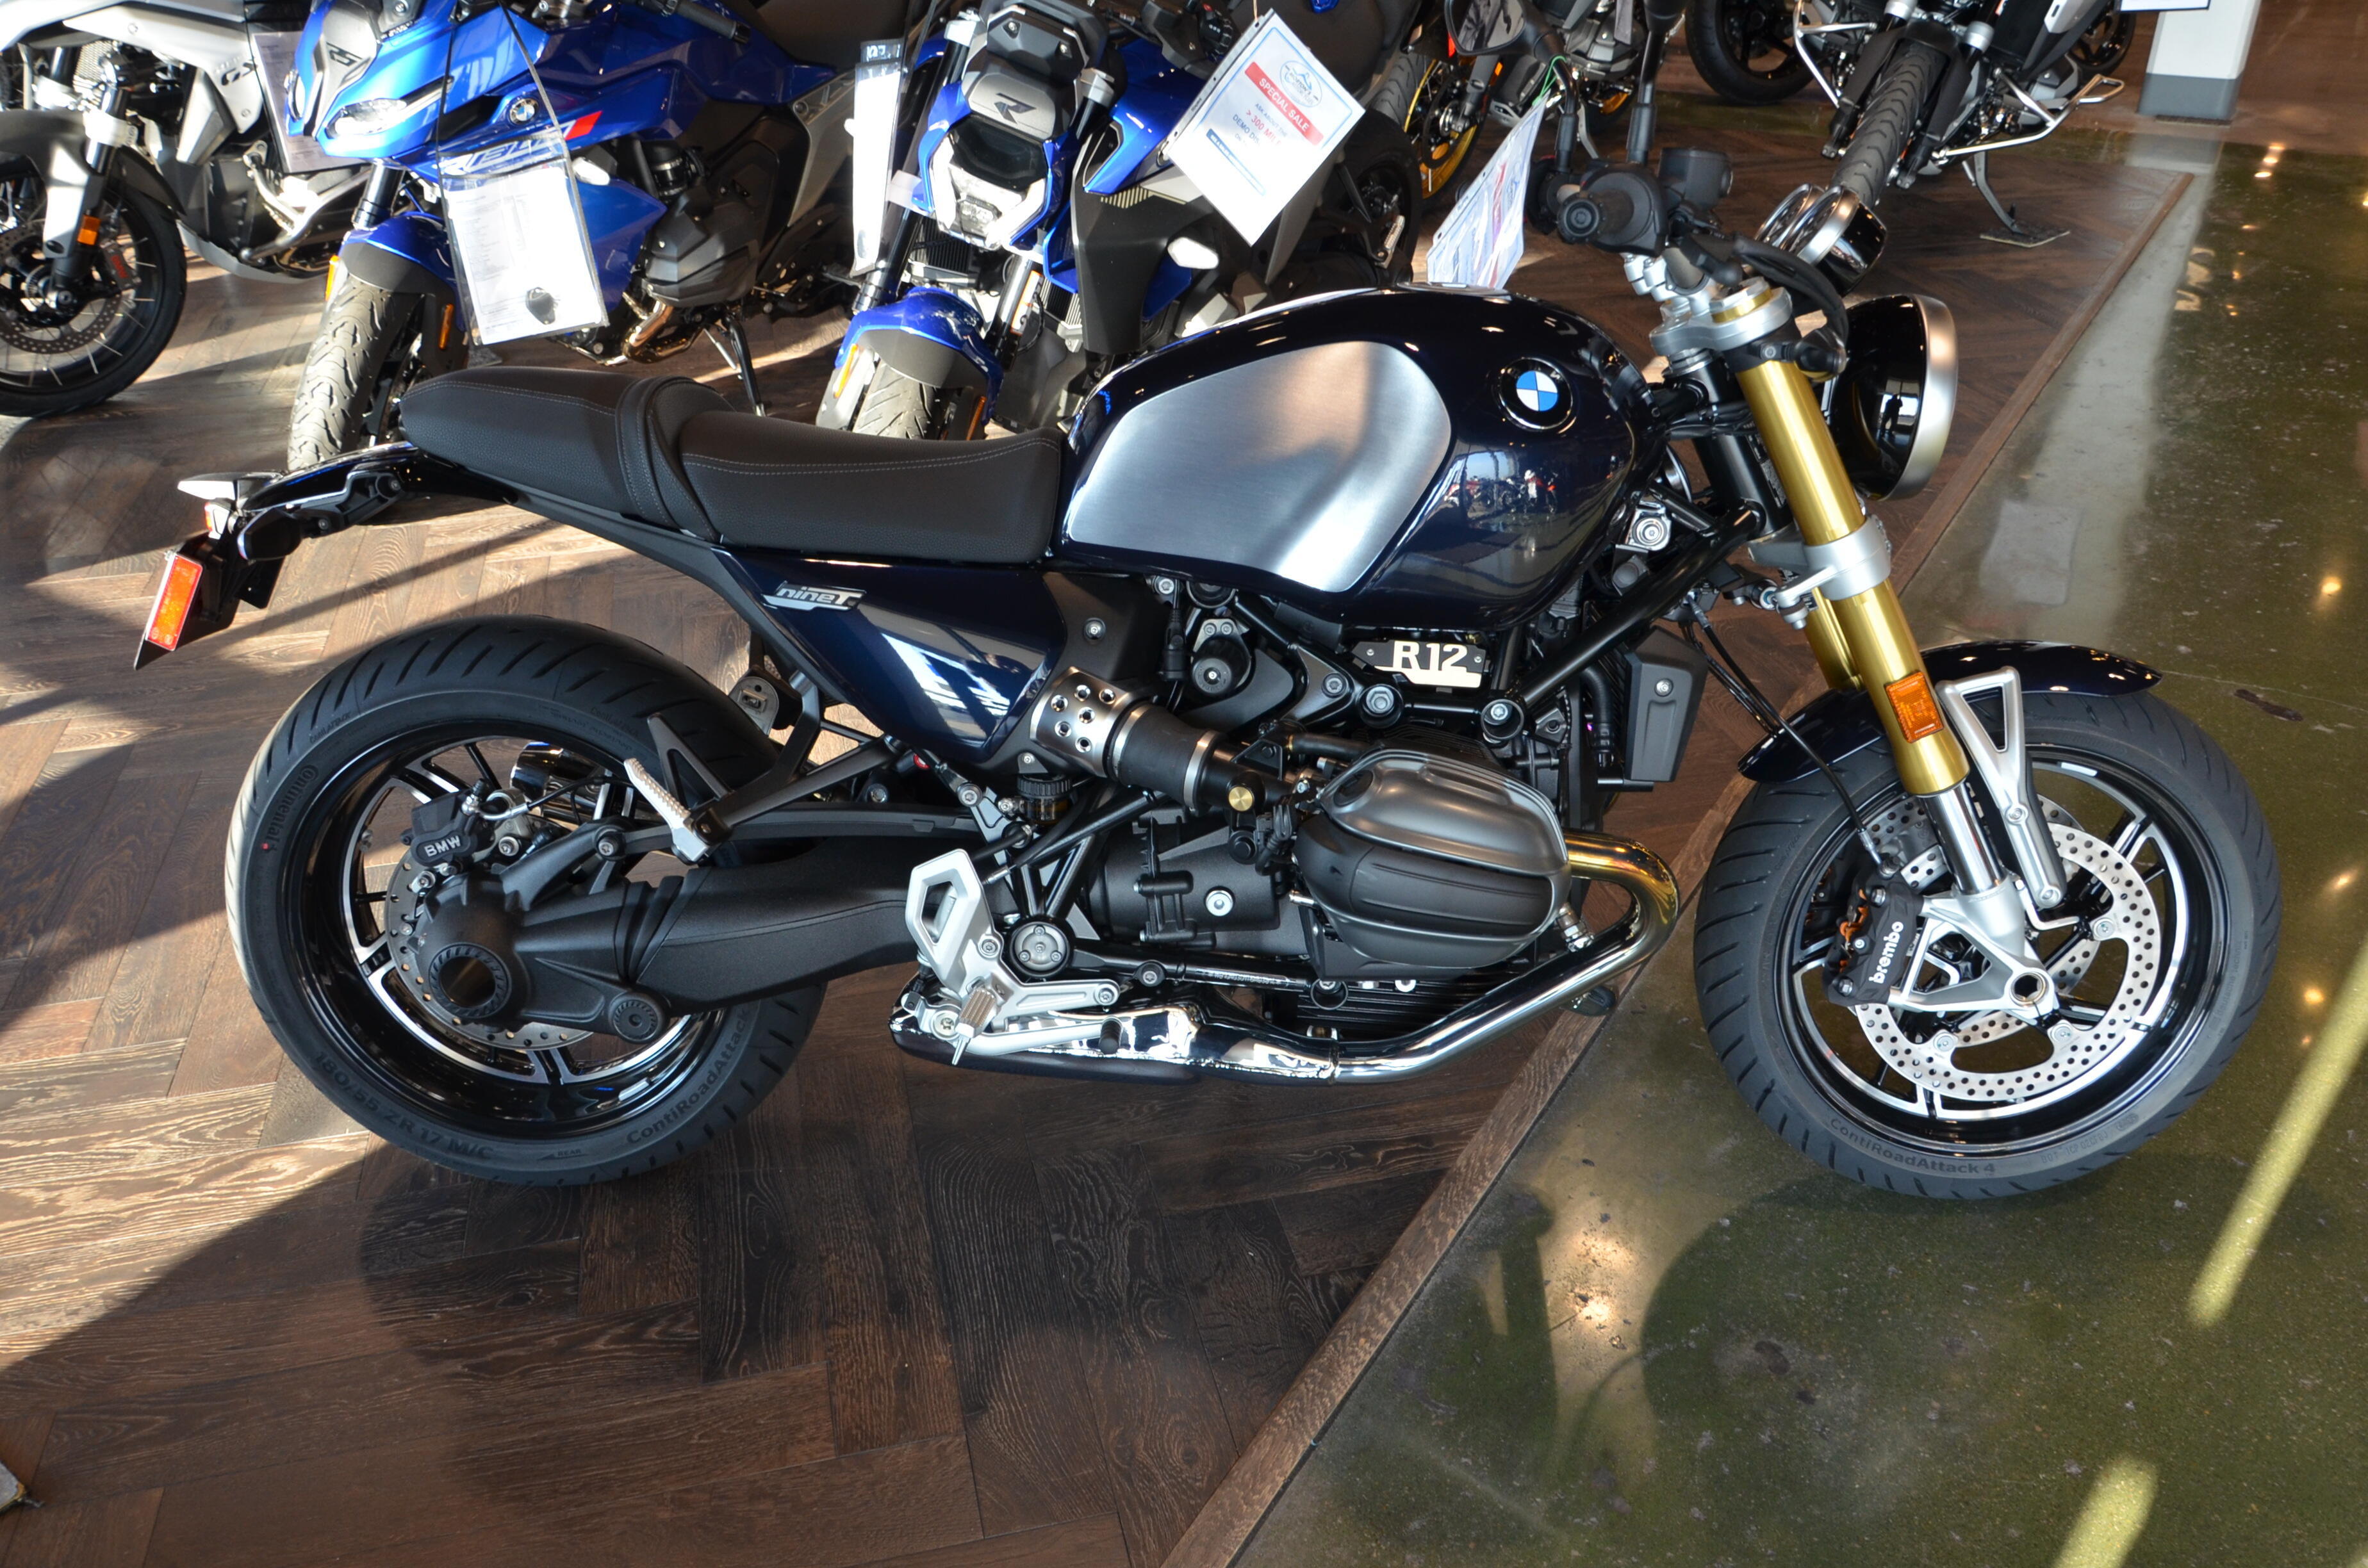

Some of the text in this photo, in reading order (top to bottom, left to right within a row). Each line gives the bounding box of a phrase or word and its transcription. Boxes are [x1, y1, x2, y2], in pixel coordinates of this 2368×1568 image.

[1232, 113, 1251, 134] DEMO
[1251, 115, 1265, 131] 300
[1259, 78, 1310, 132] SPECIAL SALE
[776, 585, 863, 605] nineT
[265, 764, 318, 842] Continental
[424, 835, 461, 857] BMW
[1868, 921, 1904, 984] brembo
[626, 1008, 752, 1144] ContiRoadAttack
[384, 1109, 416, 1134] ZR
[420, 1127, 443, 1147] 17
[1830, 1117, 1996, 1174] ContiRoadAttack 4
